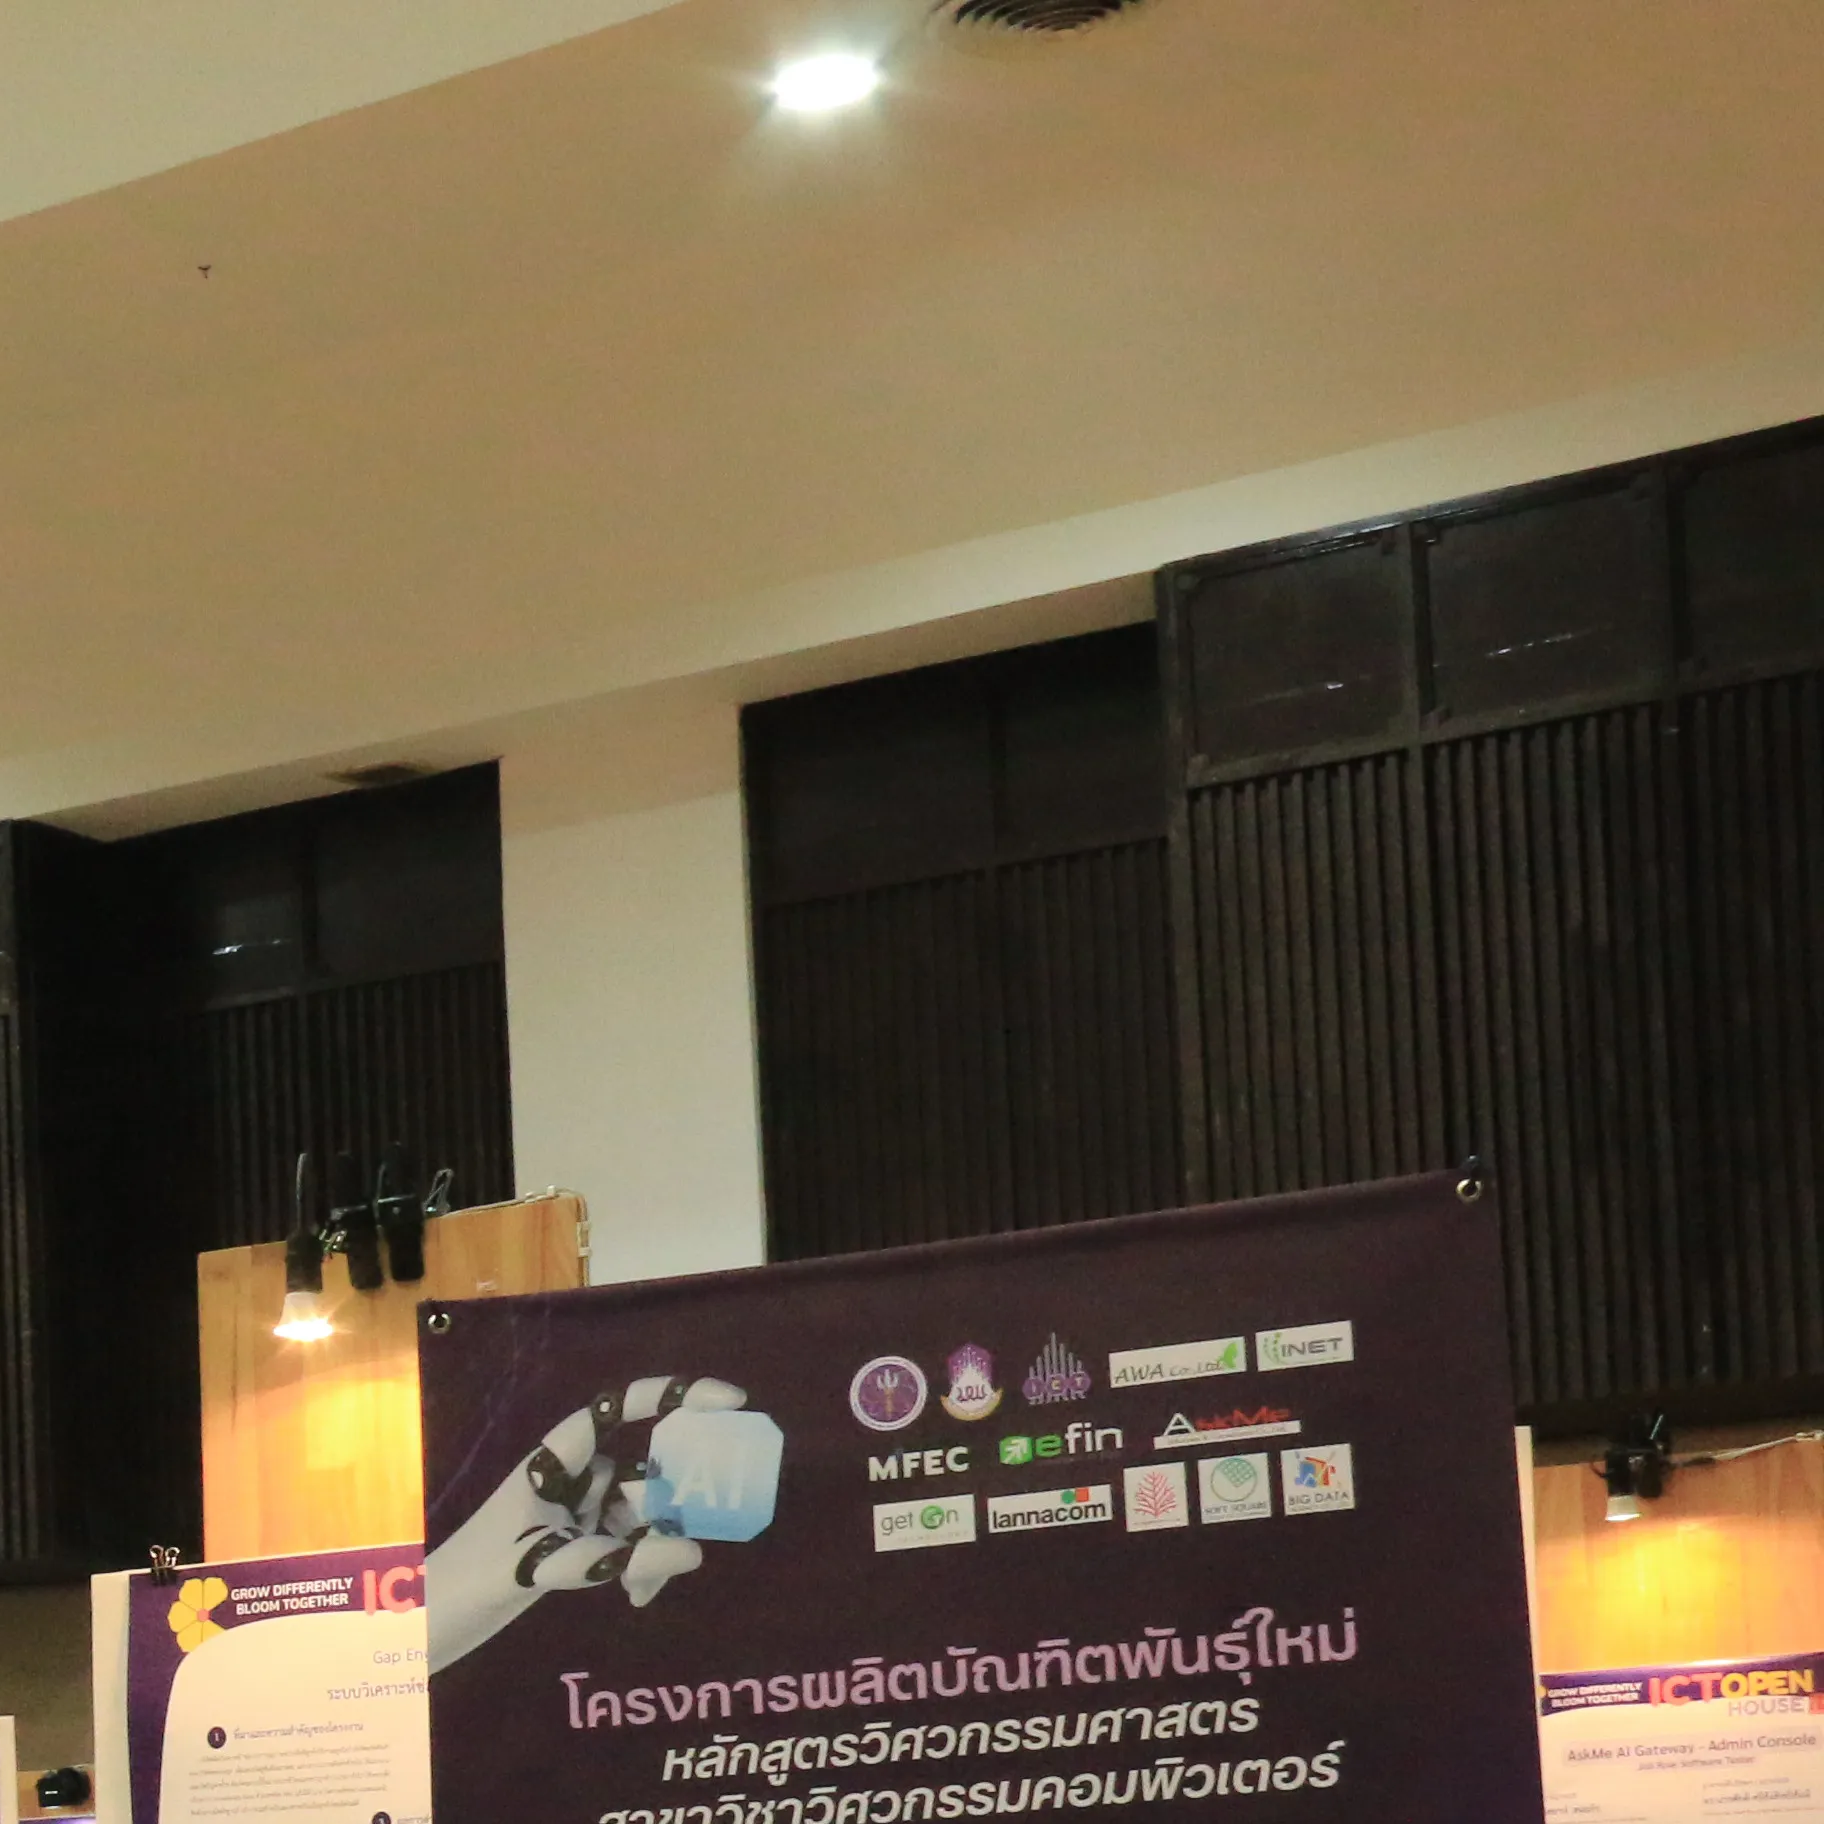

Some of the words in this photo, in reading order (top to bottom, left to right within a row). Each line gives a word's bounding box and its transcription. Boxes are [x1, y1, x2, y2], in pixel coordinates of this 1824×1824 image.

[1280, 1337, 1344, 1358] INET
[1114, 1363, 1164, 1384] AWA
[1034, 1421, 1124, 1459] efin
[867, 1446, 970, 1482] MFEC
[1288, 1491, 1311, 1506] BIG
[1315, 1490, 1350, 1503] DATA
[992, 1501, 1106, 1530] lannacom
[231, 1585, 270, 1601] GROW
[273, 1577, 353, 1597] DIFFERENTLY
[236, 1600, 280, 1615] BLOOM
[283, 1593, 349, 1610] TOGETHER
[373, 1650, 401, 1666] Gap
[560, 1606, 1357, 1729] โครงการผลิตบัณฑิตพันธุ์ใหม่
[326, 1677, 427, 1701] ระบบวิเคราะห์ช่
[1649, 1672, 1723, 1707] ICT
[1719, 1669, 1815, 1699] OPEN
[1728, 1697, 1803, 1716] HOUSE
[1635, 1743, 1695, 1760] Gateway
[1709, 1737, 1753, 1751] Admin
[1757, 1734, 1817, 1748] Console
